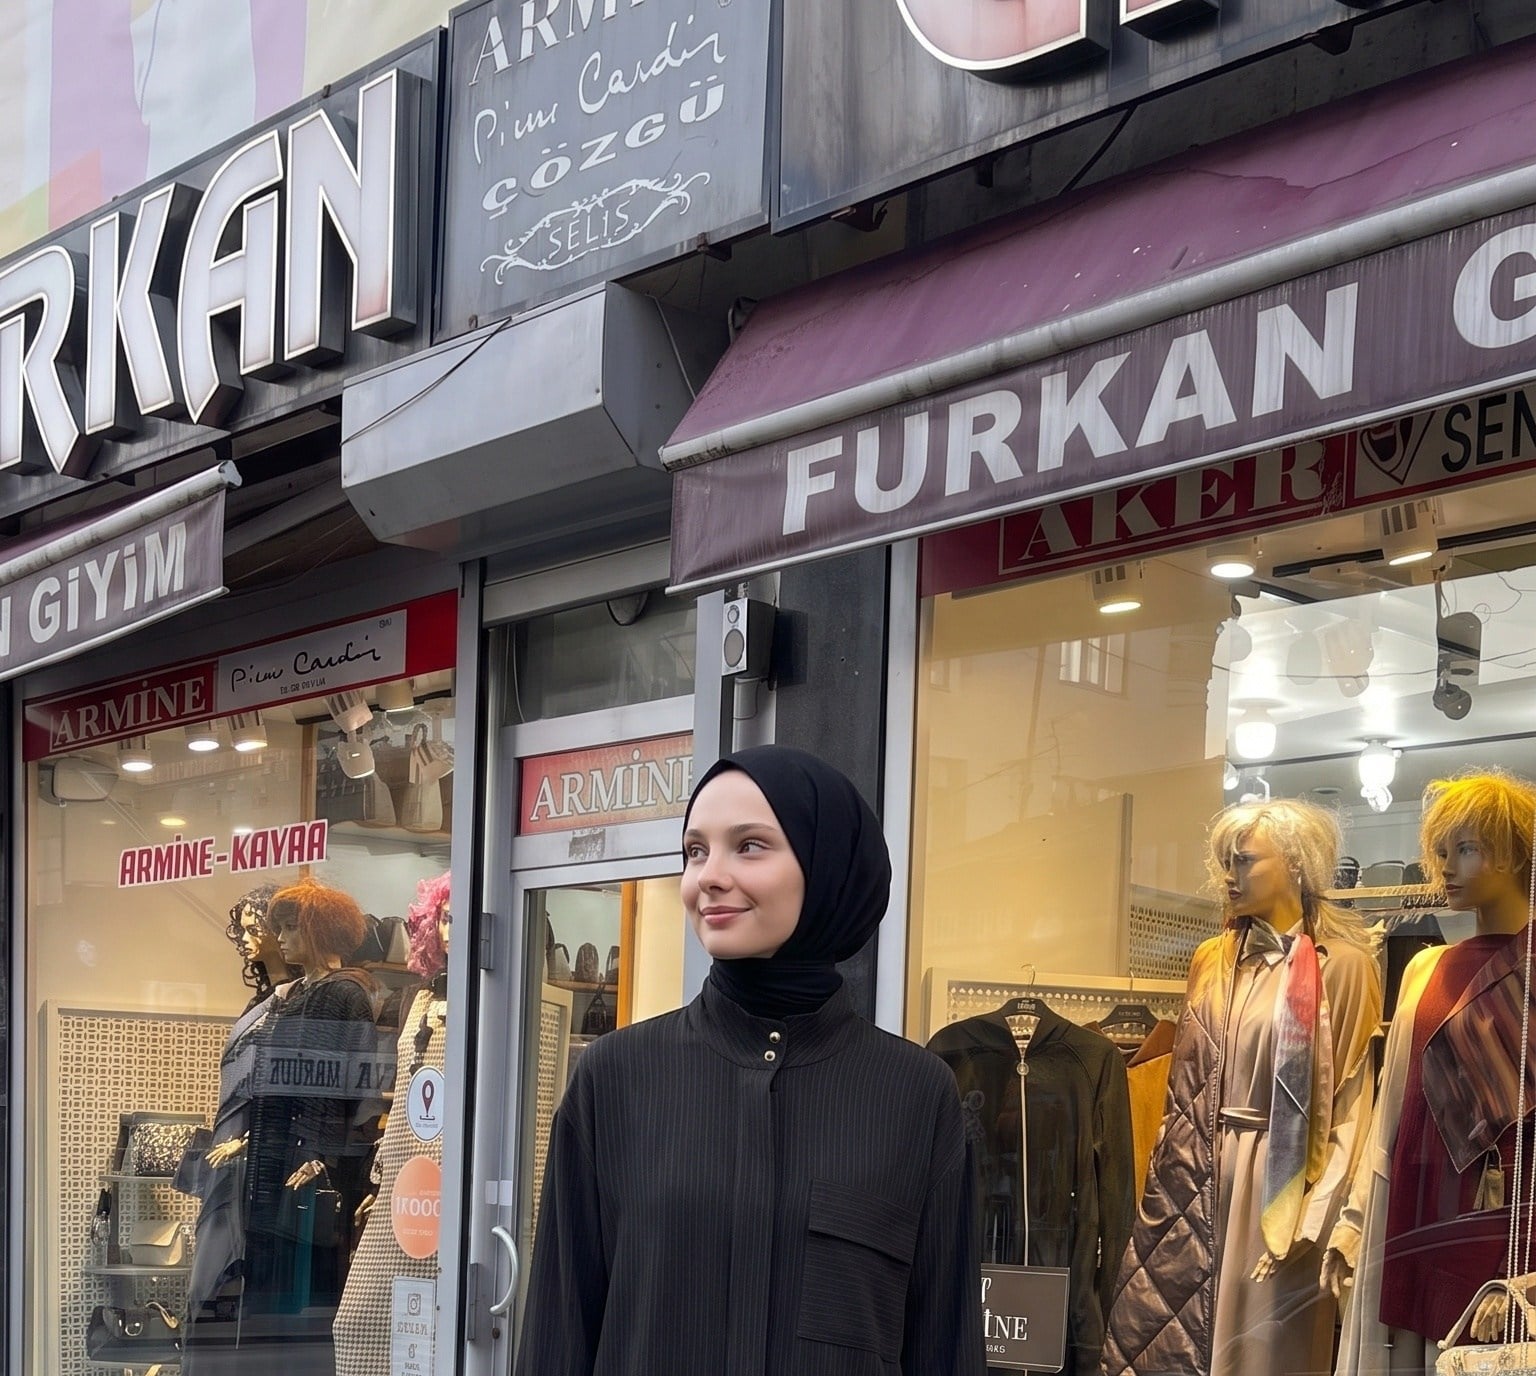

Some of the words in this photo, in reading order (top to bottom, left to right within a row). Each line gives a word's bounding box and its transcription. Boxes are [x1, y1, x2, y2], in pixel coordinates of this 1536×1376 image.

[578, 14, 727, 114] Cardin
[482, 75, 725, 220] ÇÖZGÜ
[782, 282, 1358, 535] FURKAN
[29, 521, 187, 644] GİYİM
[54, 676, 206, 746] ARMİNE
